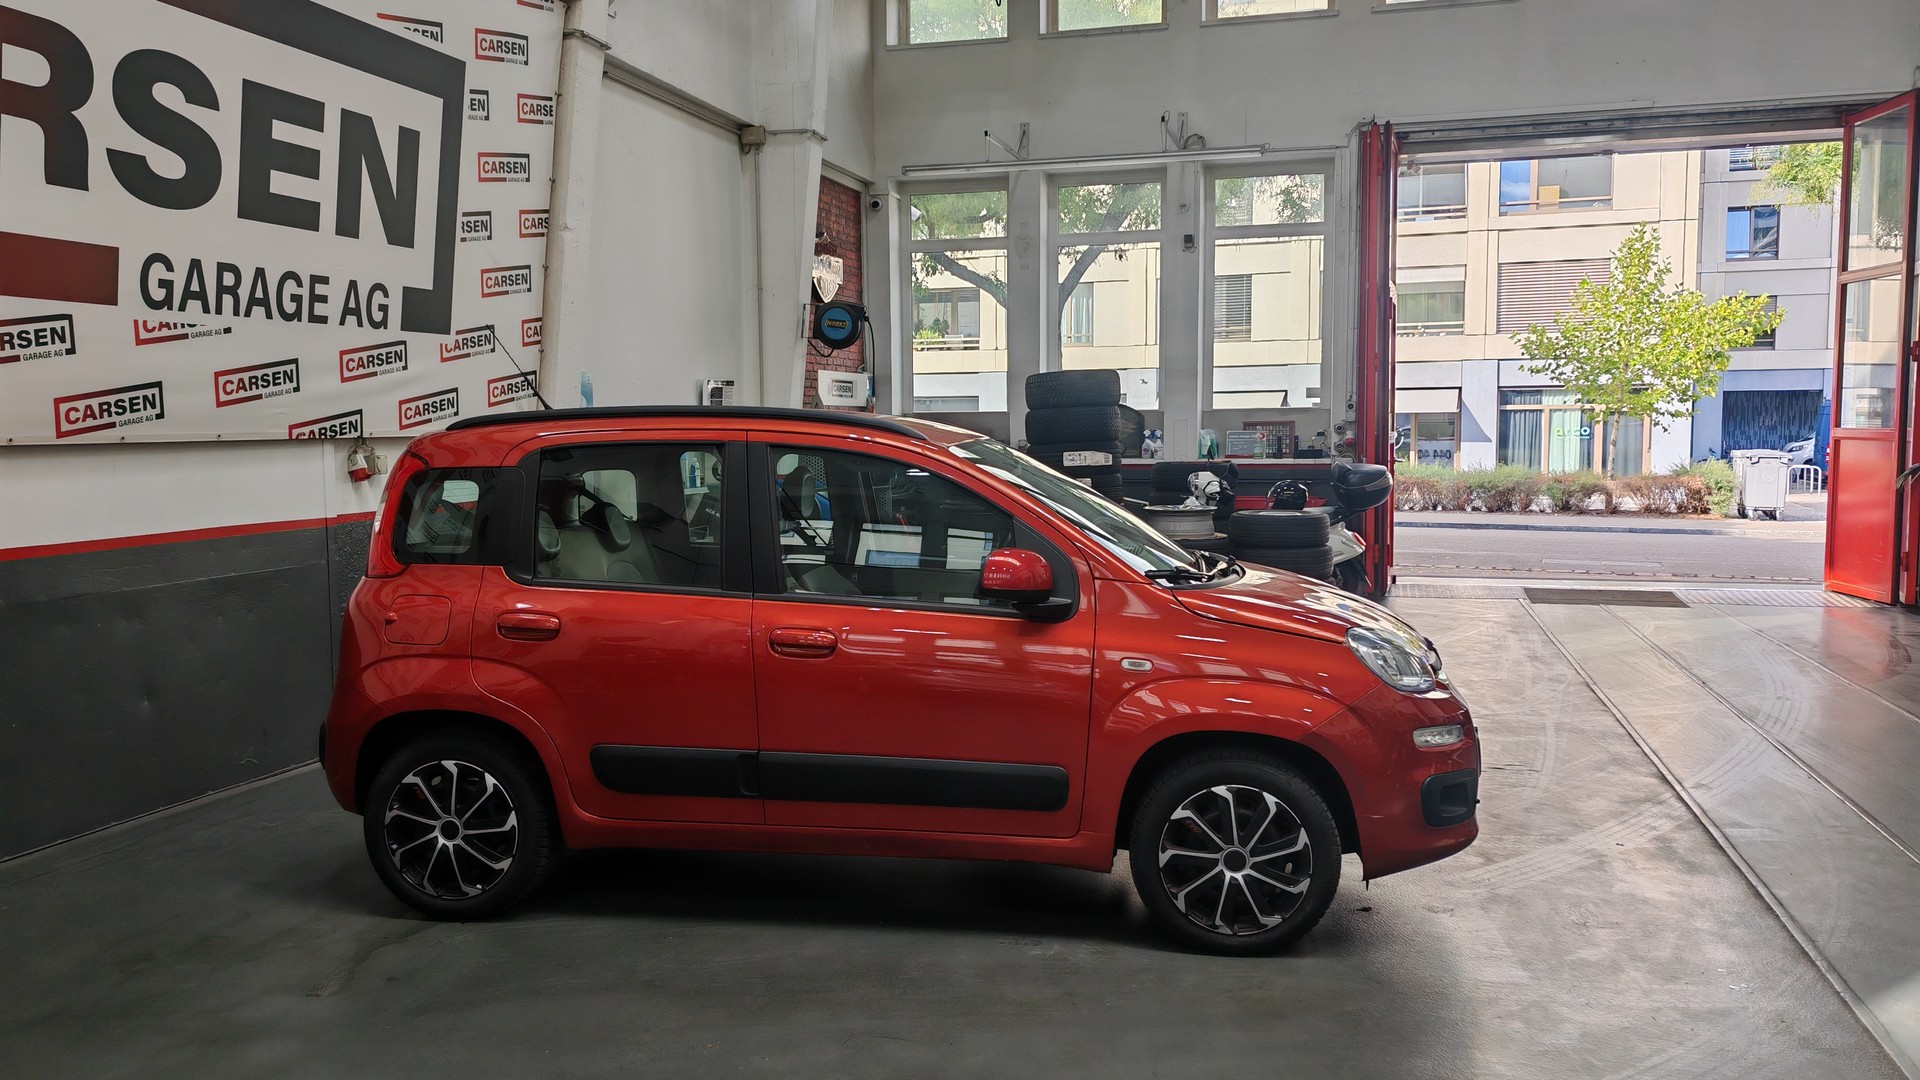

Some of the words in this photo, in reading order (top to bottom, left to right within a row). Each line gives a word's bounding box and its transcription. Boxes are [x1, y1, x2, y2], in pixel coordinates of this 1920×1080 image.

[479, 38, 525, 56] CARSEN
[482, 161, 526, 174] CARSEN
[485, 273, 528, 289] CARSEN
[139, 253, 329, 324] GARAGE
[339, 280, 390, 329] AG
[191, 330, 213, 339] GARAGE
[23, 350, 52, 362] GARAGE
[53, 349, 63, 357] AG
[345, 349, 403, 372] CARSEN
[471, 350, 485, 358] GARAGE
[378, 367, 395, 376] GARAGE
[222, 368, 294, 396] CARSEN
[492, 378, 533, 398] CARSEN
[264, 389, 284, 399] GARAGE
[64, 393, 156, 425] CARSEN
[404, 396, 455, 420] CARSEN
[118, 416, 144, 428] GARAGE
[145, 414, 154, 423] AG
[433, 414, 448, 422] GARAGE
